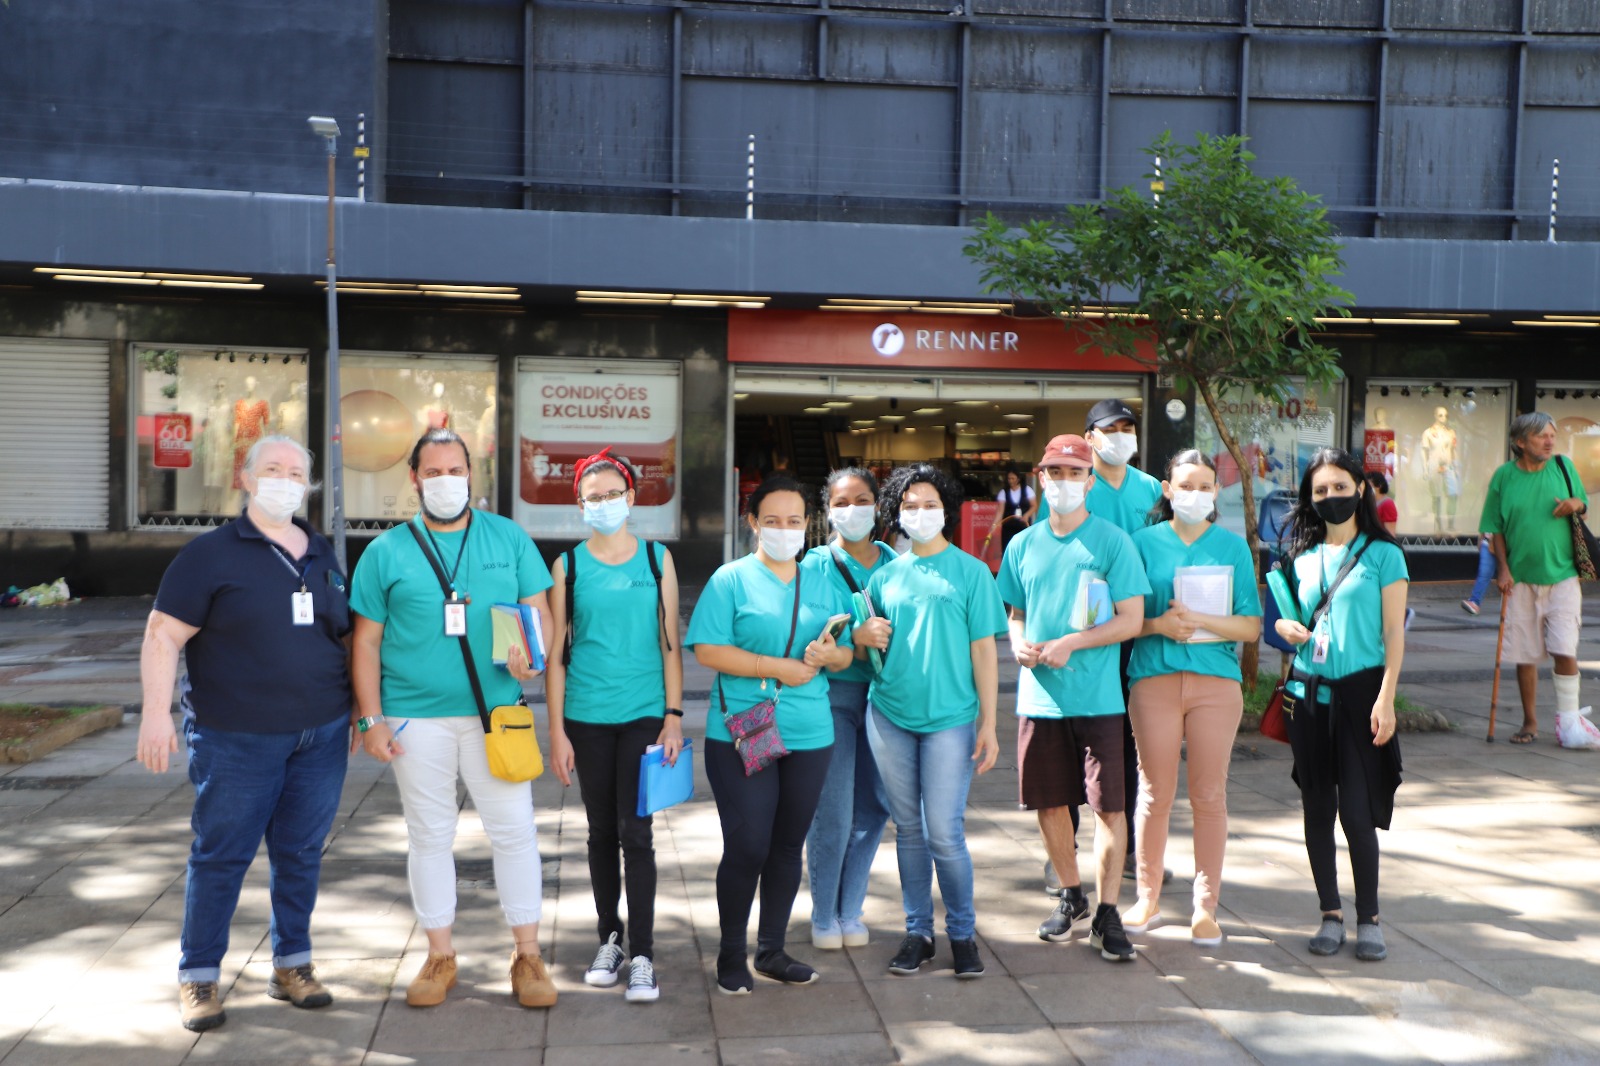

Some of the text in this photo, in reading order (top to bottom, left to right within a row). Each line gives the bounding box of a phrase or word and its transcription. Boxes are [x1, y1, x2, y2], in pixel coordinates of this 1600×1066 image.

[916, 329, 1019, 351] RENNER
[541, 383, 648, 404] CONDIÇÕES
[542, 404, 652, 419] EXCLUSIVAS
[159, 424, 187, 441] 60
[1366, 440, 1388, 456] 60
[534, 455, 563, 477] 5x
[482, 562, 496, 570] SOS
